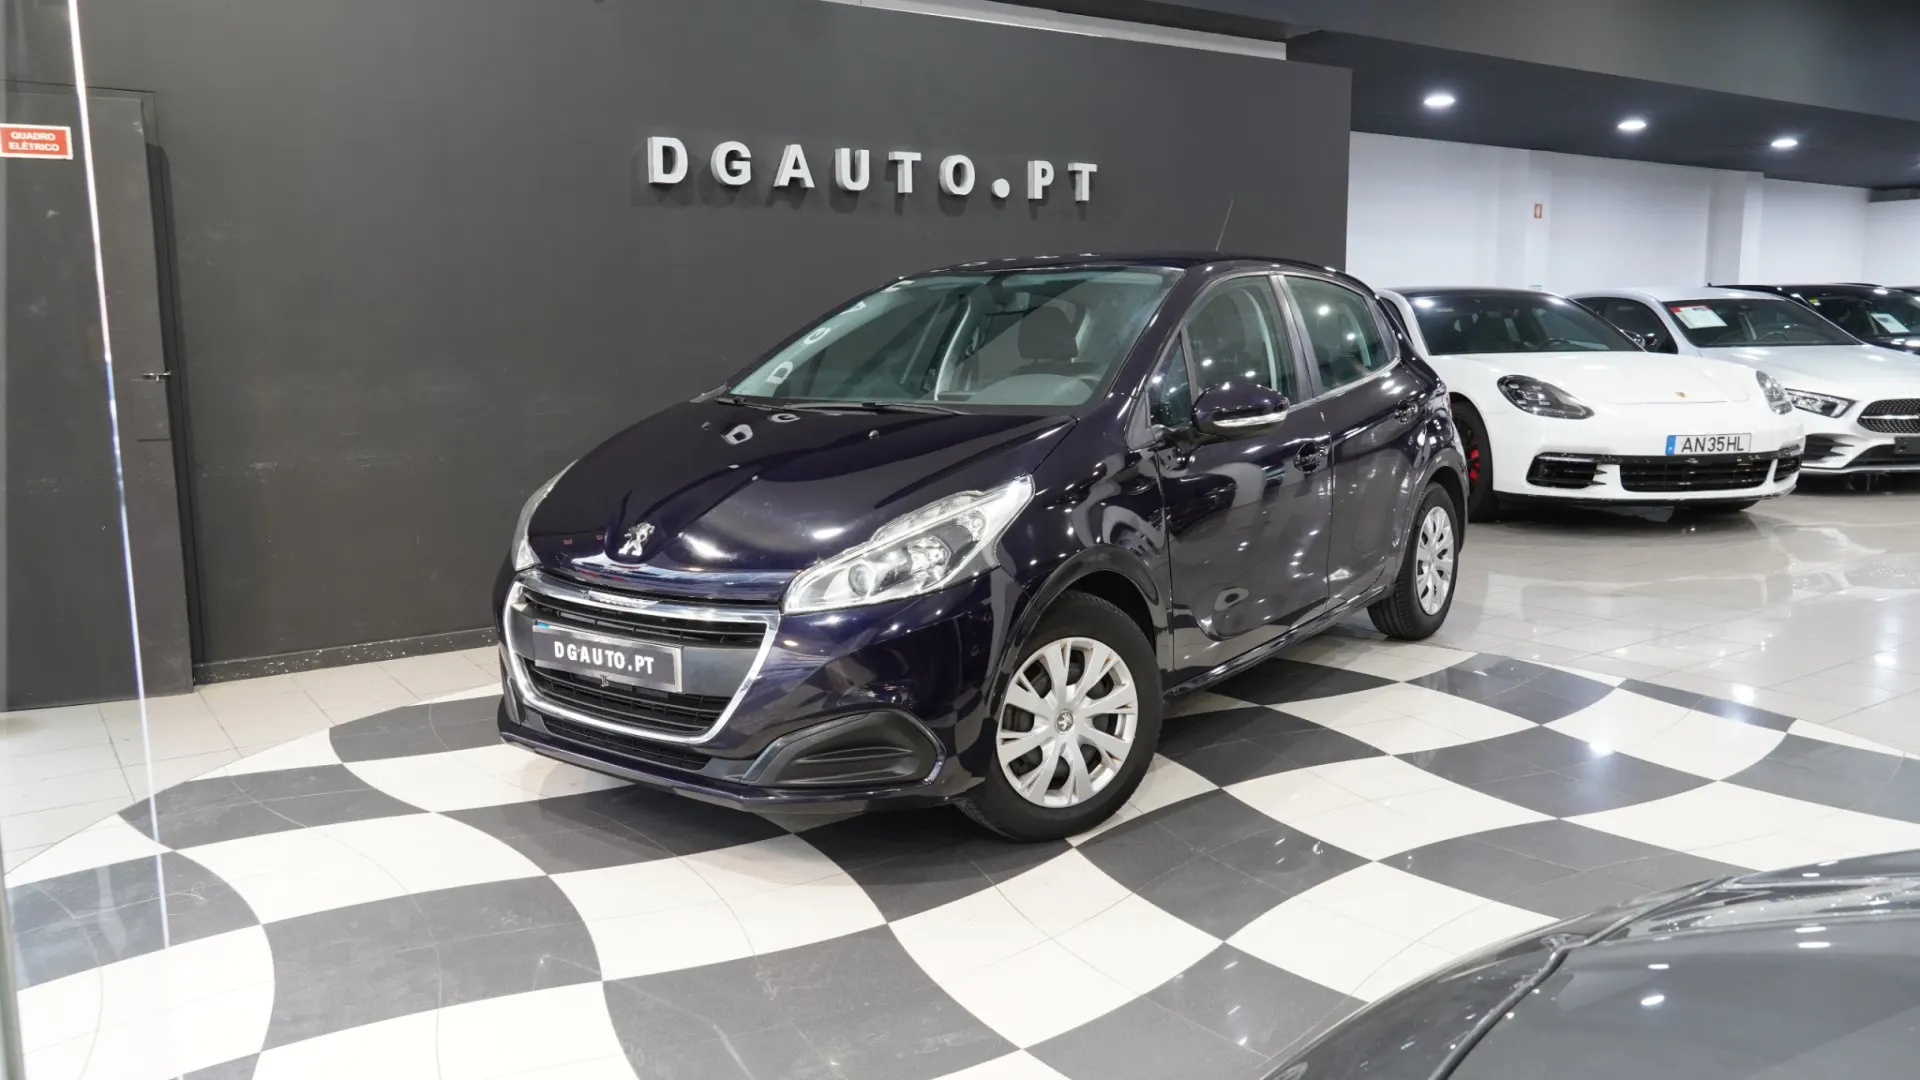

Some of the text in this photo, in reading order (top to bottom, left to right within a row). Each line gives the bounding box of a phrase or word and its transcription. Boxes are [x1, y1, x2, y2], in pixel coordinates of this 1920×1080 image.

[10, 131, 56, 141] QUADRO
[8, 141, 60, 151] ELÉTRICO
[553, 641, 654, 674] DGAUTO.PT
